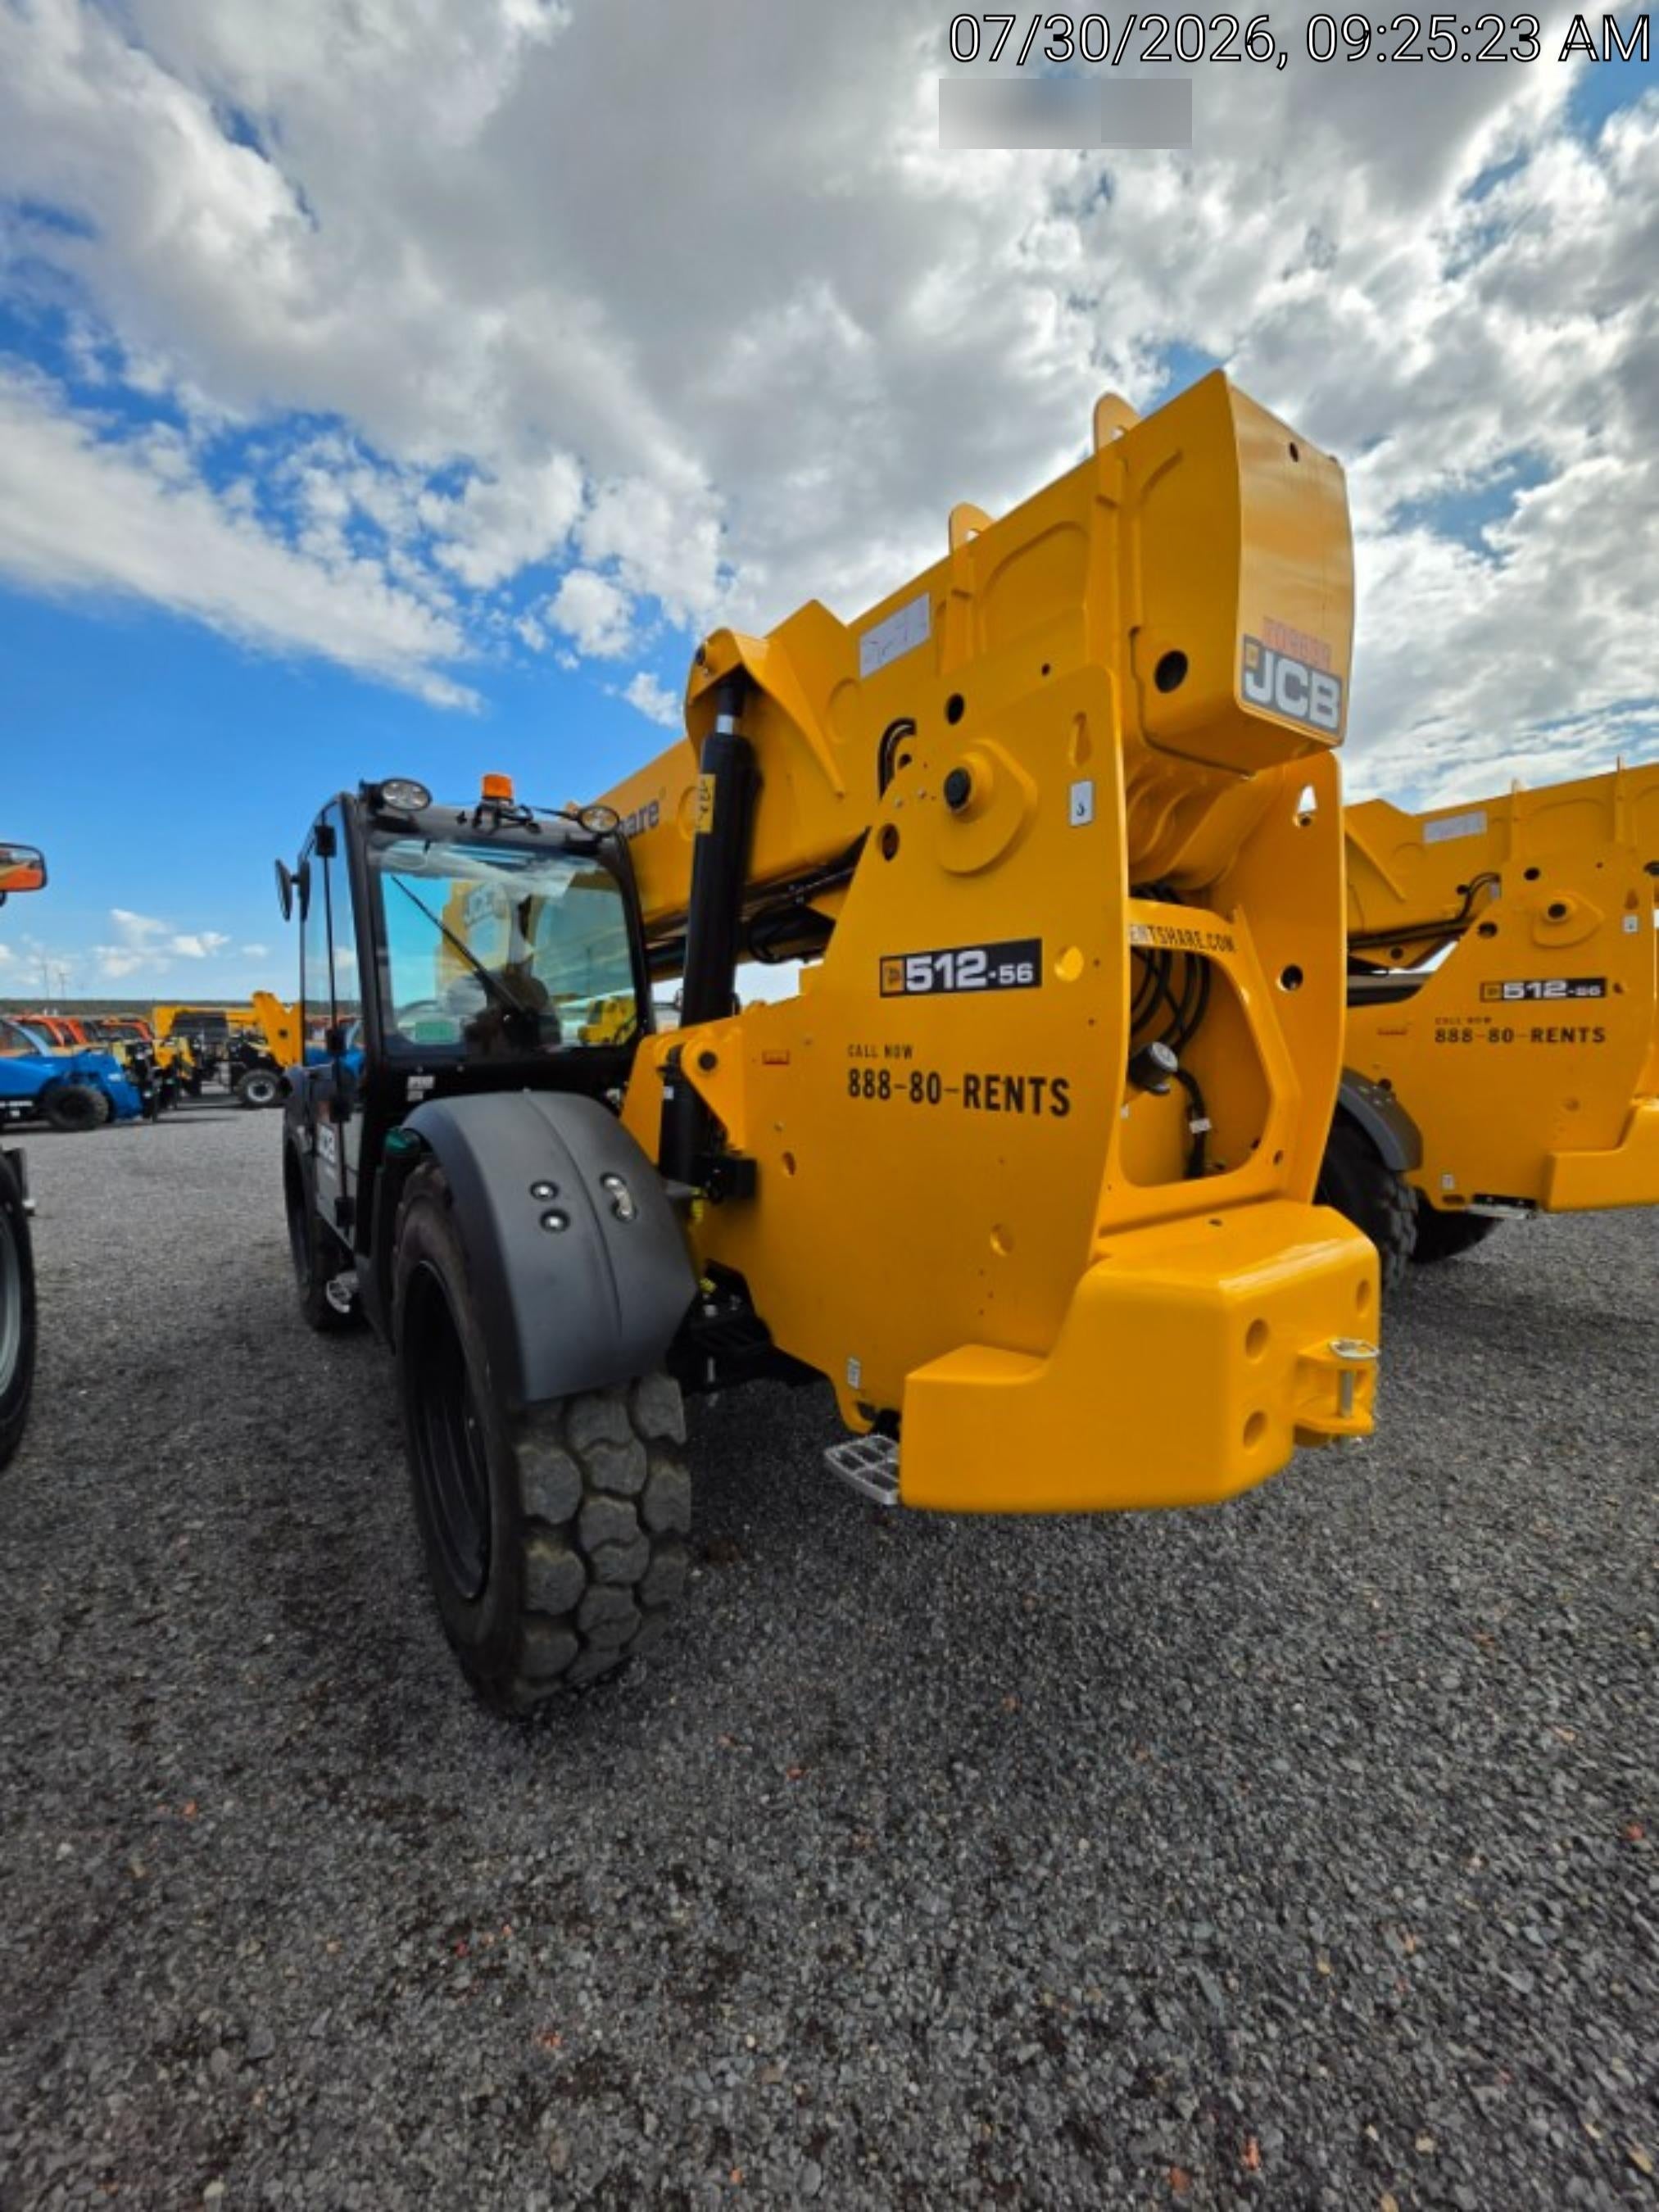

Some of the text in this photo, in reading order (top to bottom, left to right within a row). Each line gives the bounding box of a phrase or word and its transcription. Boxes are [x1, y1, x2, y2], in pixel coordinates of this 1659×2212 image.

[1244, 650, 1342, 729] JCB
[848, 1044, 913, 1059] CALL NOW
[1435, 1027, 1606, 1044] 888-80-RENTS
[848, 1068, 1071, 1117] 888-80-RENTS
